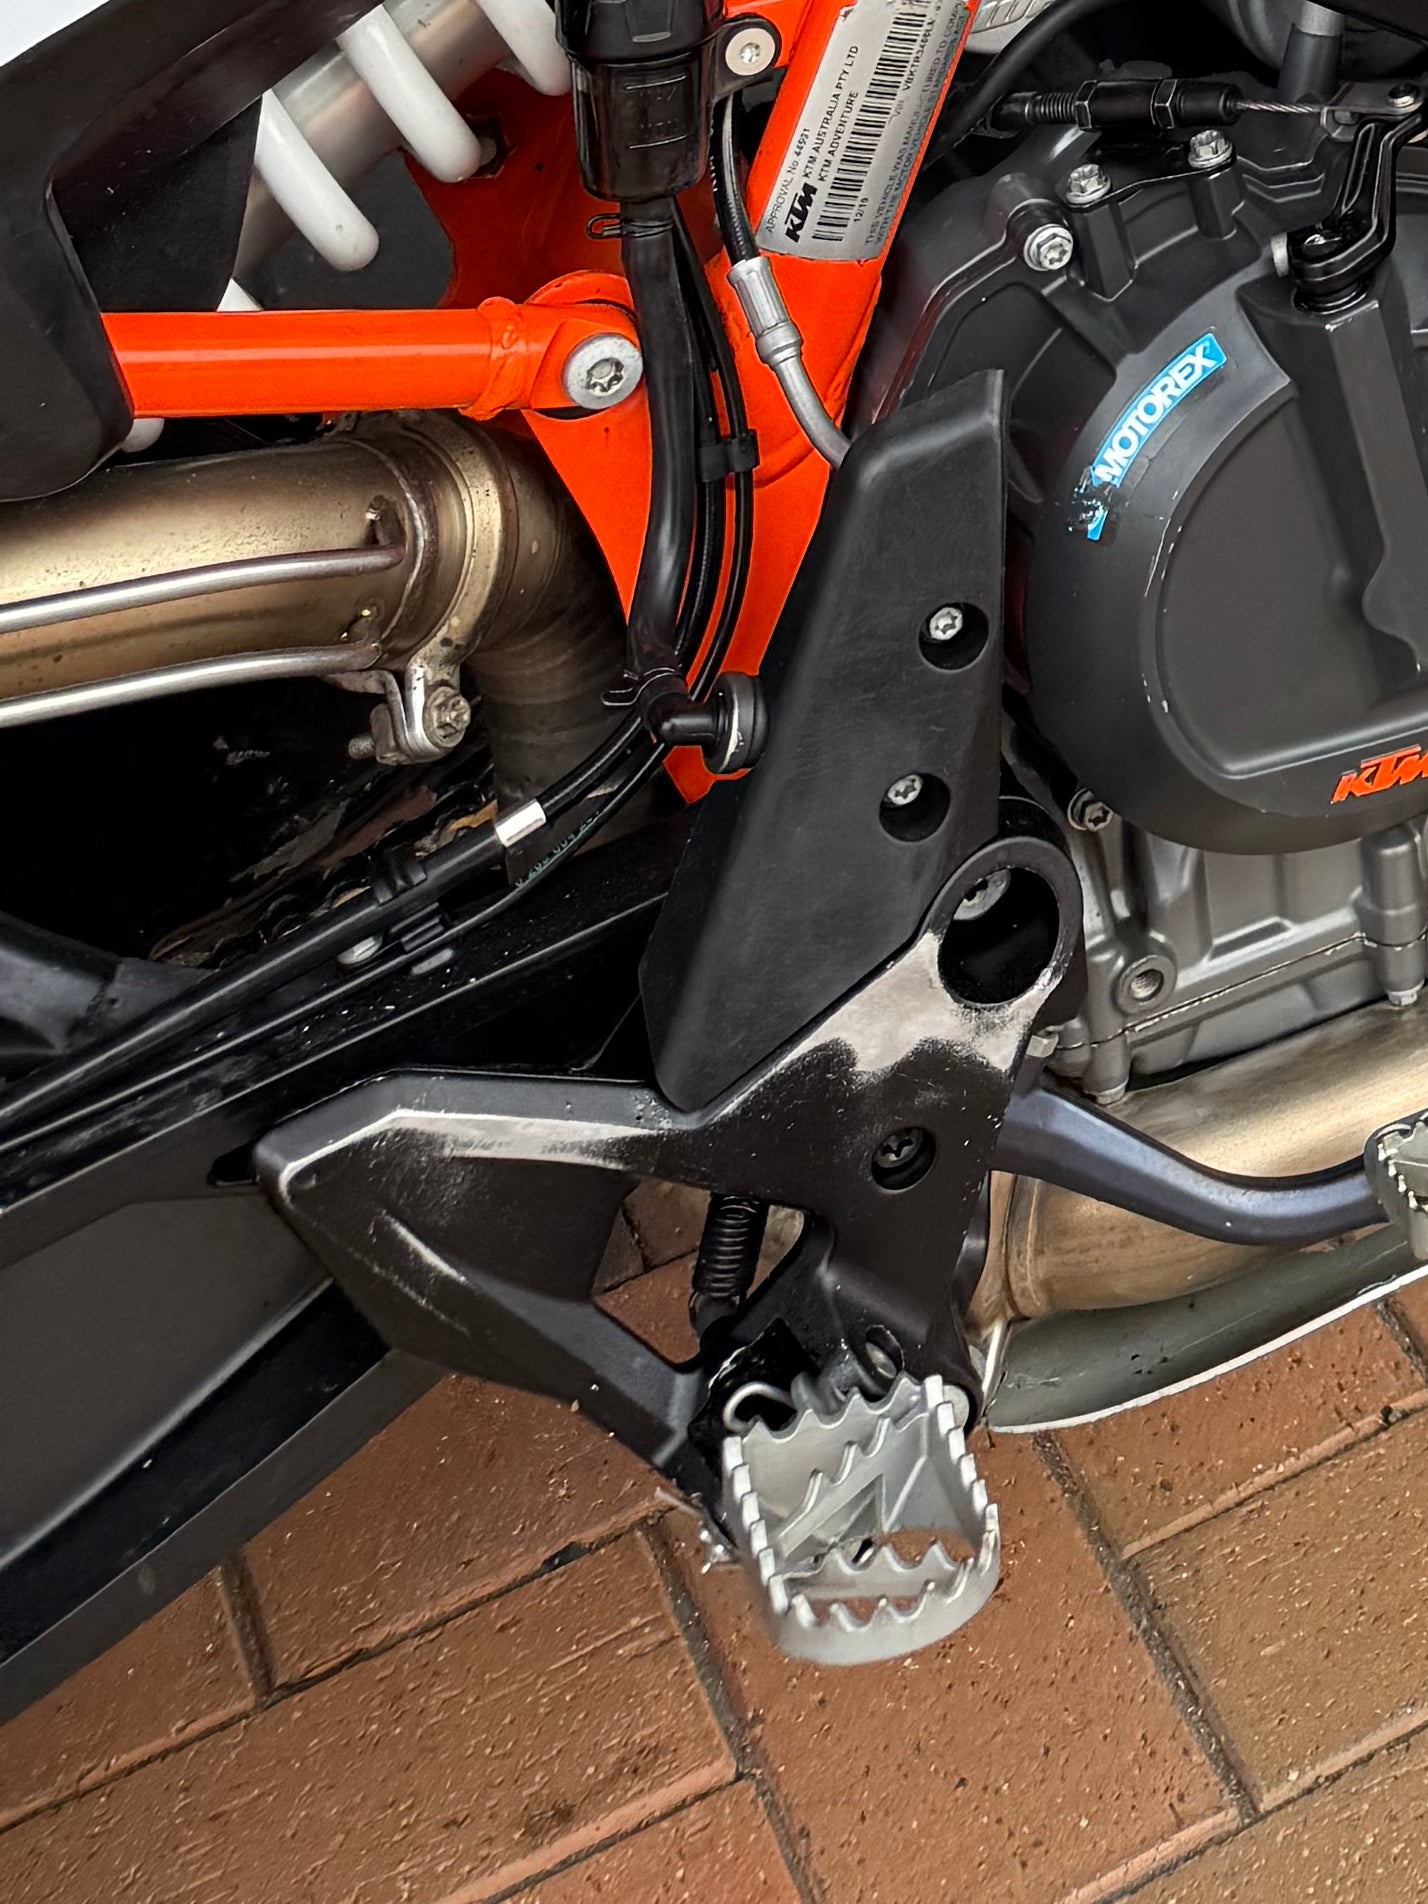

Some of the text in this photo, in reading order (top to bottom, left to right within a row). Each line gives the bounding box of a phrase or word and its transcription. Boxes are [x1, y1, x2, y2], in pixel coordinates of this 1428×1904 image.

[801, 44, 859, 179] KTM AUSTRALIA PTY LTD
[817, 89, 857, 182] KTM ADVENTURE
[778, 180, 820, 243] KTM
[1094, 341, 1217, 483] MOTOREX
